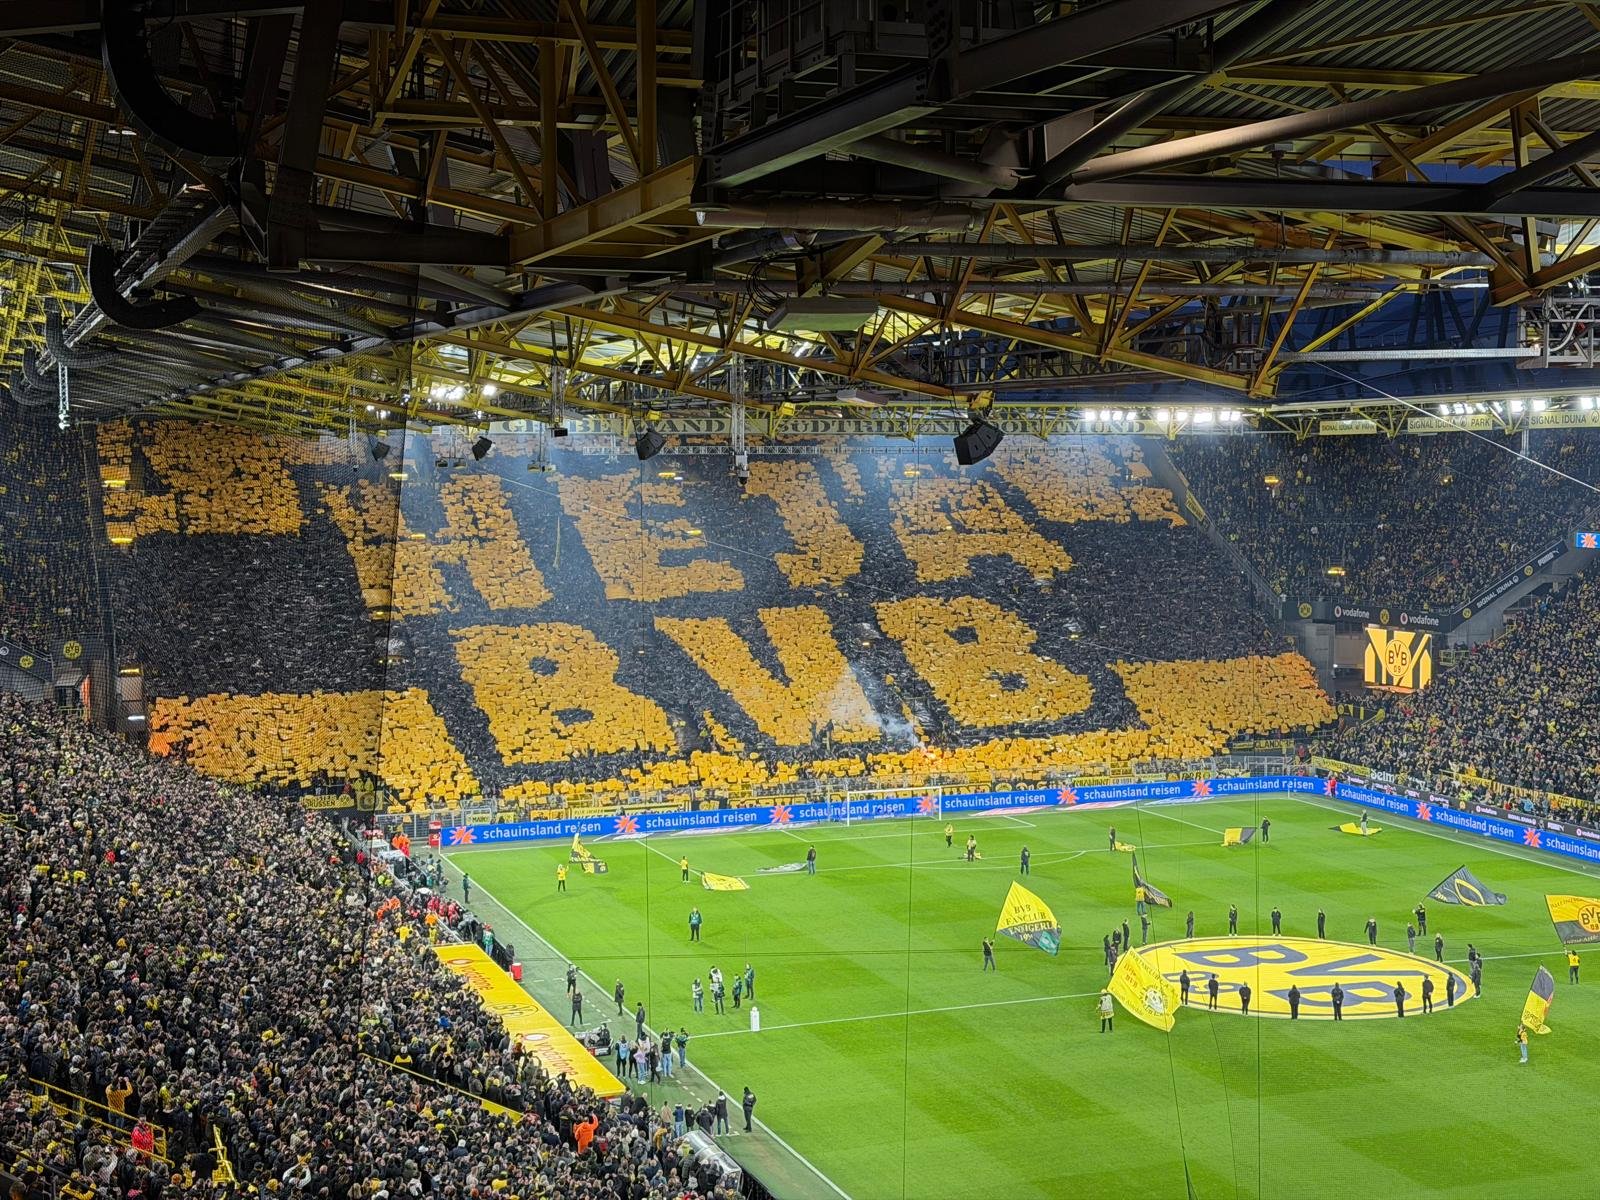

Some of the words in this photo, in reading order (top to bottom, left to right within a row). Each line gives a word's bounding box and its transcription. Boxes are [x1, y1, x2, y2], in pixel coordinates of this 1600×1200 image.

[986, 420, 1145, 432] ORTMUND
[1409, 419, 1433, 429] SIGNAL
[1471, 418, 1490, 427] PARK
[1531, 414, 1559, 424] SIGNAL
[1561, 414, 1586, 423] IDUNA
[1342, 608, 1370, 618] vodafone
[1409, 615, 1439, 626] vodafone
[1388, 644, 1408, 666] BVB
[1393, 666, 1401, 674] 09
[449, 595, 1093, 765] BVB
[1084, 785, 1148, 800] schauinsland
[1151, 784, 1180, 795] reisen
[1218, 779, 1280, 792] schauinsland
[1282, 778, 1314, 790] reisen
[945, 795, 1011, 808] schauinsland
[1015, 793, 1045, 804] reisen
[1341, 788, 1385, 807] schauinsland
[1387, 799, 1409, 812] reisen
[800, 803, 869, 818] schauinsand
[873, 801, 905, 814] reisen
[646, 813, 720, 828] schauinsland
[723, 811, 757, 823] reisen
[1436, 809, 1487, 831] schauinsland
[1488, 823, 1514, 838] reisen
[484, 822, 560, 839] schauinsland
[1546, 836, 1600, 859] schauinslan
[1006, 912, 1046, 925] FANCLUB
[1172, 943, 1434, 1007] BVB
